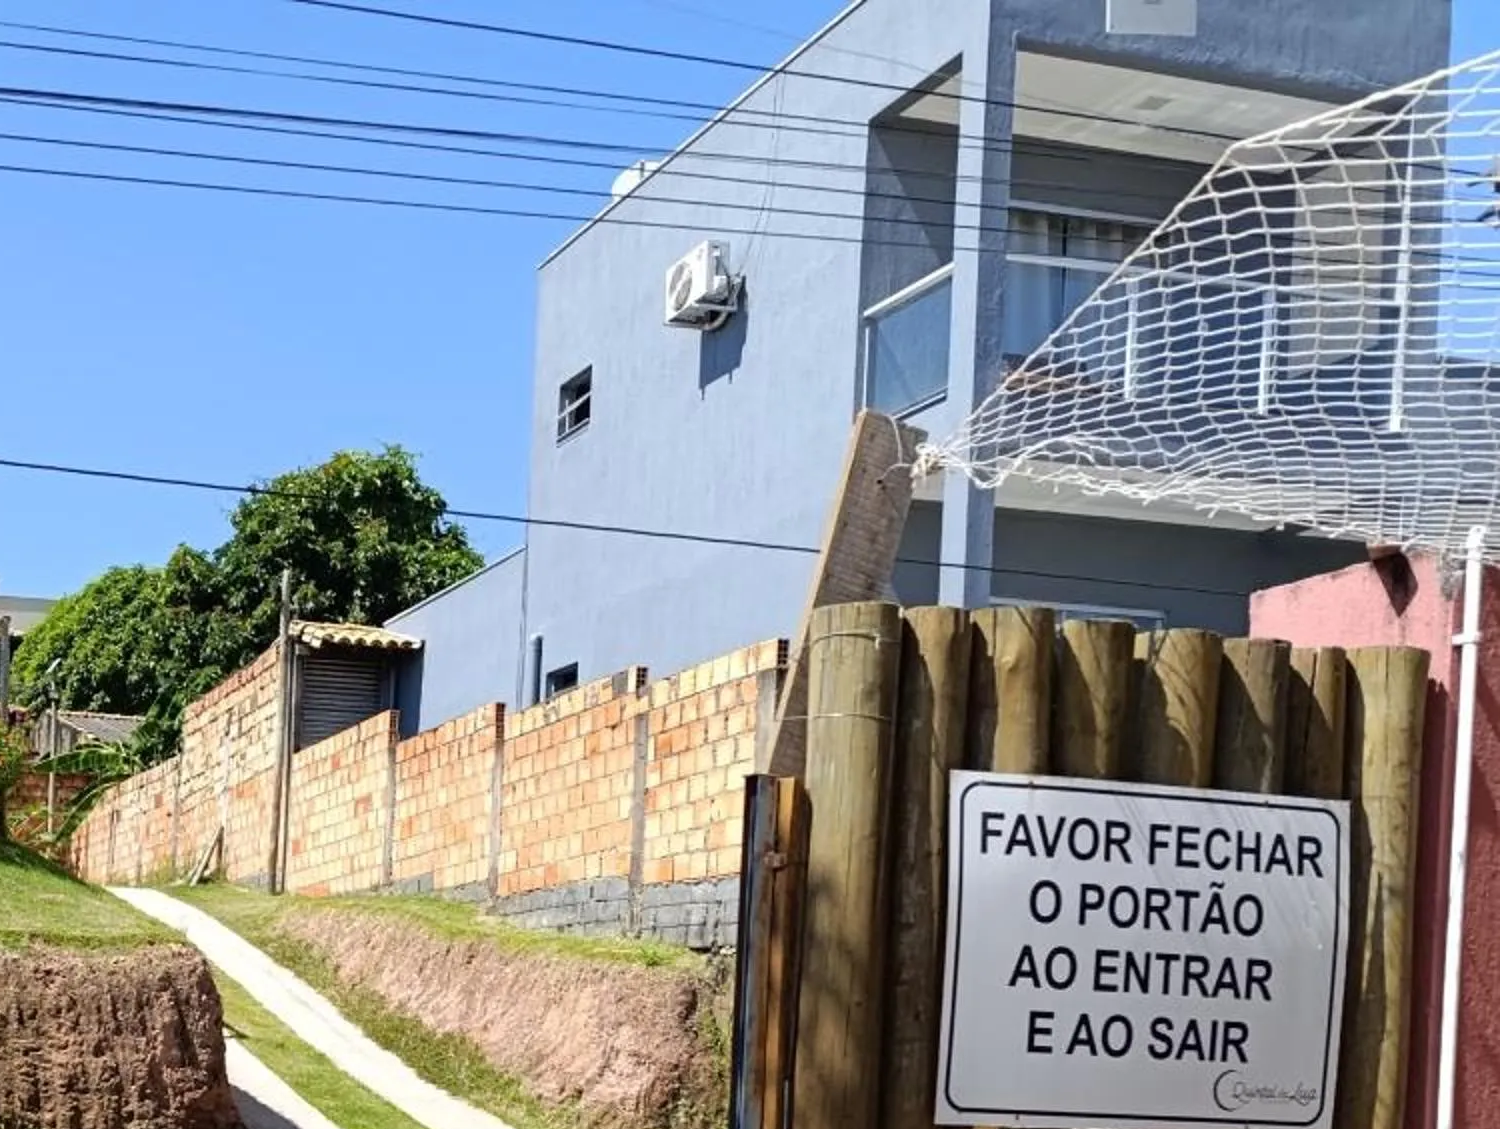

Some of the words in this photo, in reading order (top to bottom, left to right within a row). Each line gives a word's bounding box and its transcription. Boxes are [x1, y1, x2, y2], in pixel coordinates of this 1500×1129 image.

[980, 811, 1132, 865] FAVOR
[1147, 822, 1325, 879] FECHAR
[1029, 879, 1062, 925] O
[1077, 880, 1265, 938] PORTÃO
[1007, 944, 1078, 991] AO
[1092, 948, 1273, 1002] ENTRAR
[1026, 1010, 1055, 1055] E
[1065, 1012, 1134, 1059] AO
[1147, 1016, 1249, 1064] SAIR
